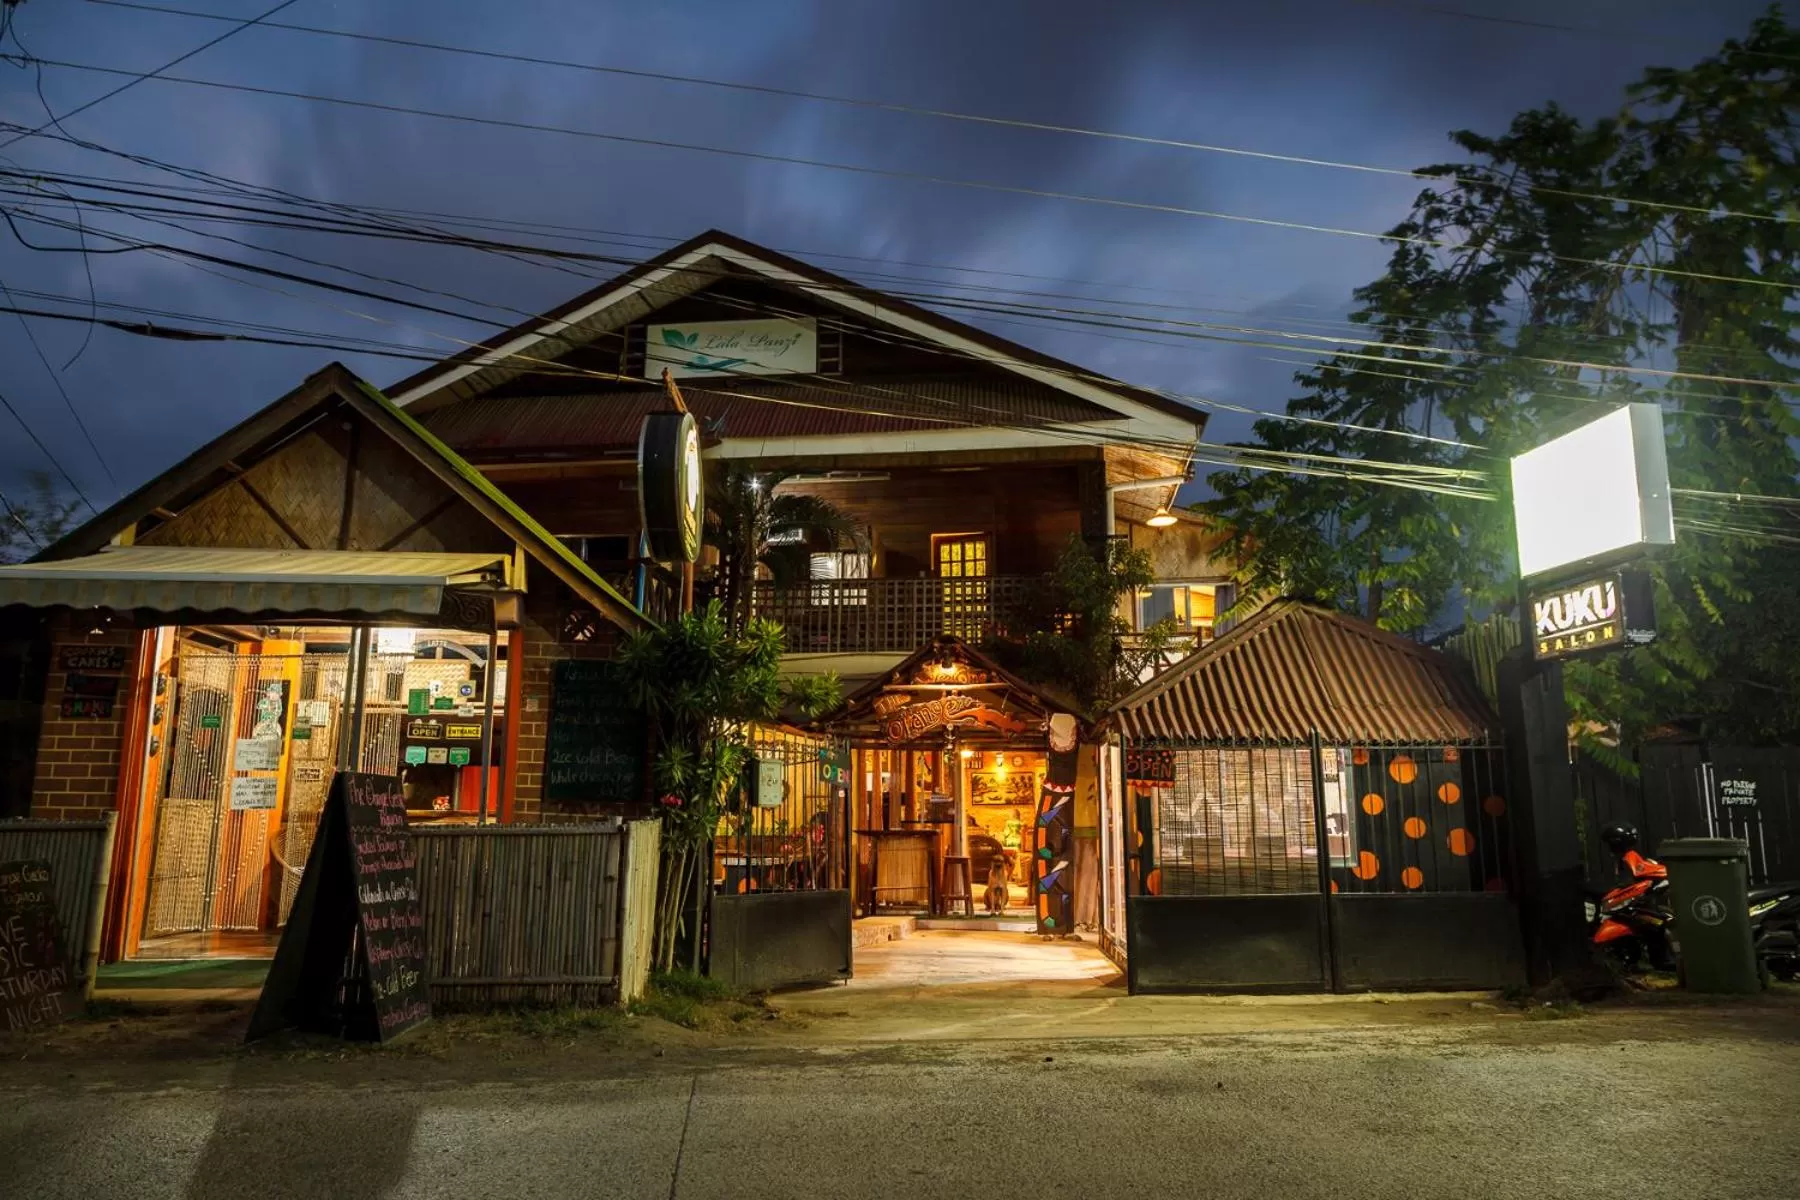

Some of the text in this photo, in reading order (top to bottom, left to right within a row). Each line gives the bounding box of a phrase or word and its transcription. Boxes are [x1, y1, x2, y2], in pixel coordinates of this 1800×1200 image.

[1535, 581, 1616, 635] KUKU
[1540, 626, 1613, 653] SALON
[412, 727, 438, 737] OPEN
[448, 726, 480, 736] ENTRANCE
[822, 763, 850, 784] OPEN
[1126, 760, 1172, 779] OPEN
[1721, 780, 1732, 788] NO
[6, 992, 63, 1031] NIGHT
